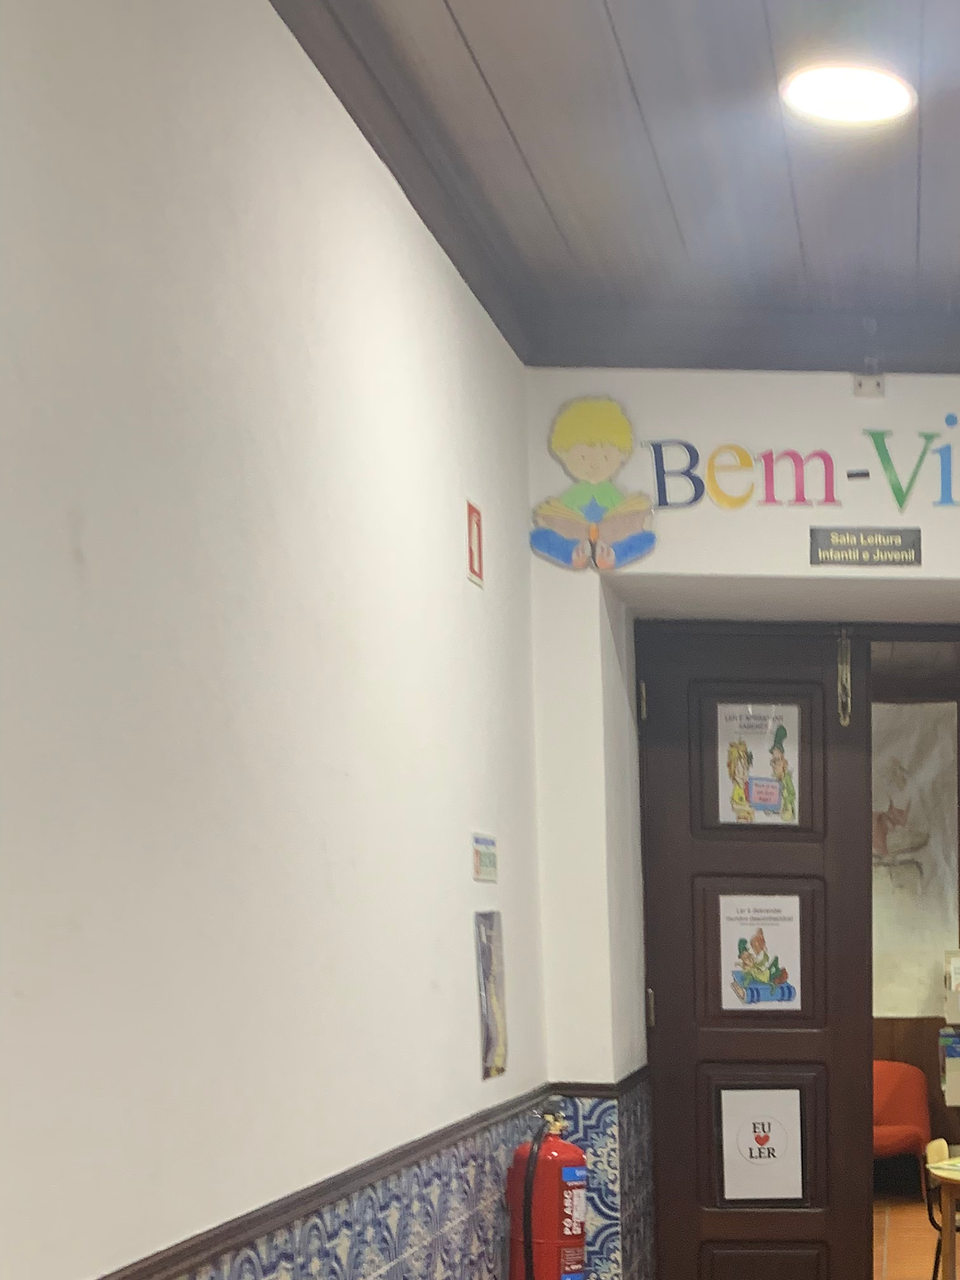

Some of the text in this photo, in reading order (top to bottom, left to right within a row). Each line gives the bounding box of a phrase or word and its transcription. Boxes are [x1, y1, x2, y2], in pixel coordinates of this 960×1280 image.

[830, 532, 902, 546] Sala Leitura
[818, 548, 915, 562] Infantil e Juvenil
[752, 1122, 772, 1133] EU
[749, 1147, 777, 1159] LER
